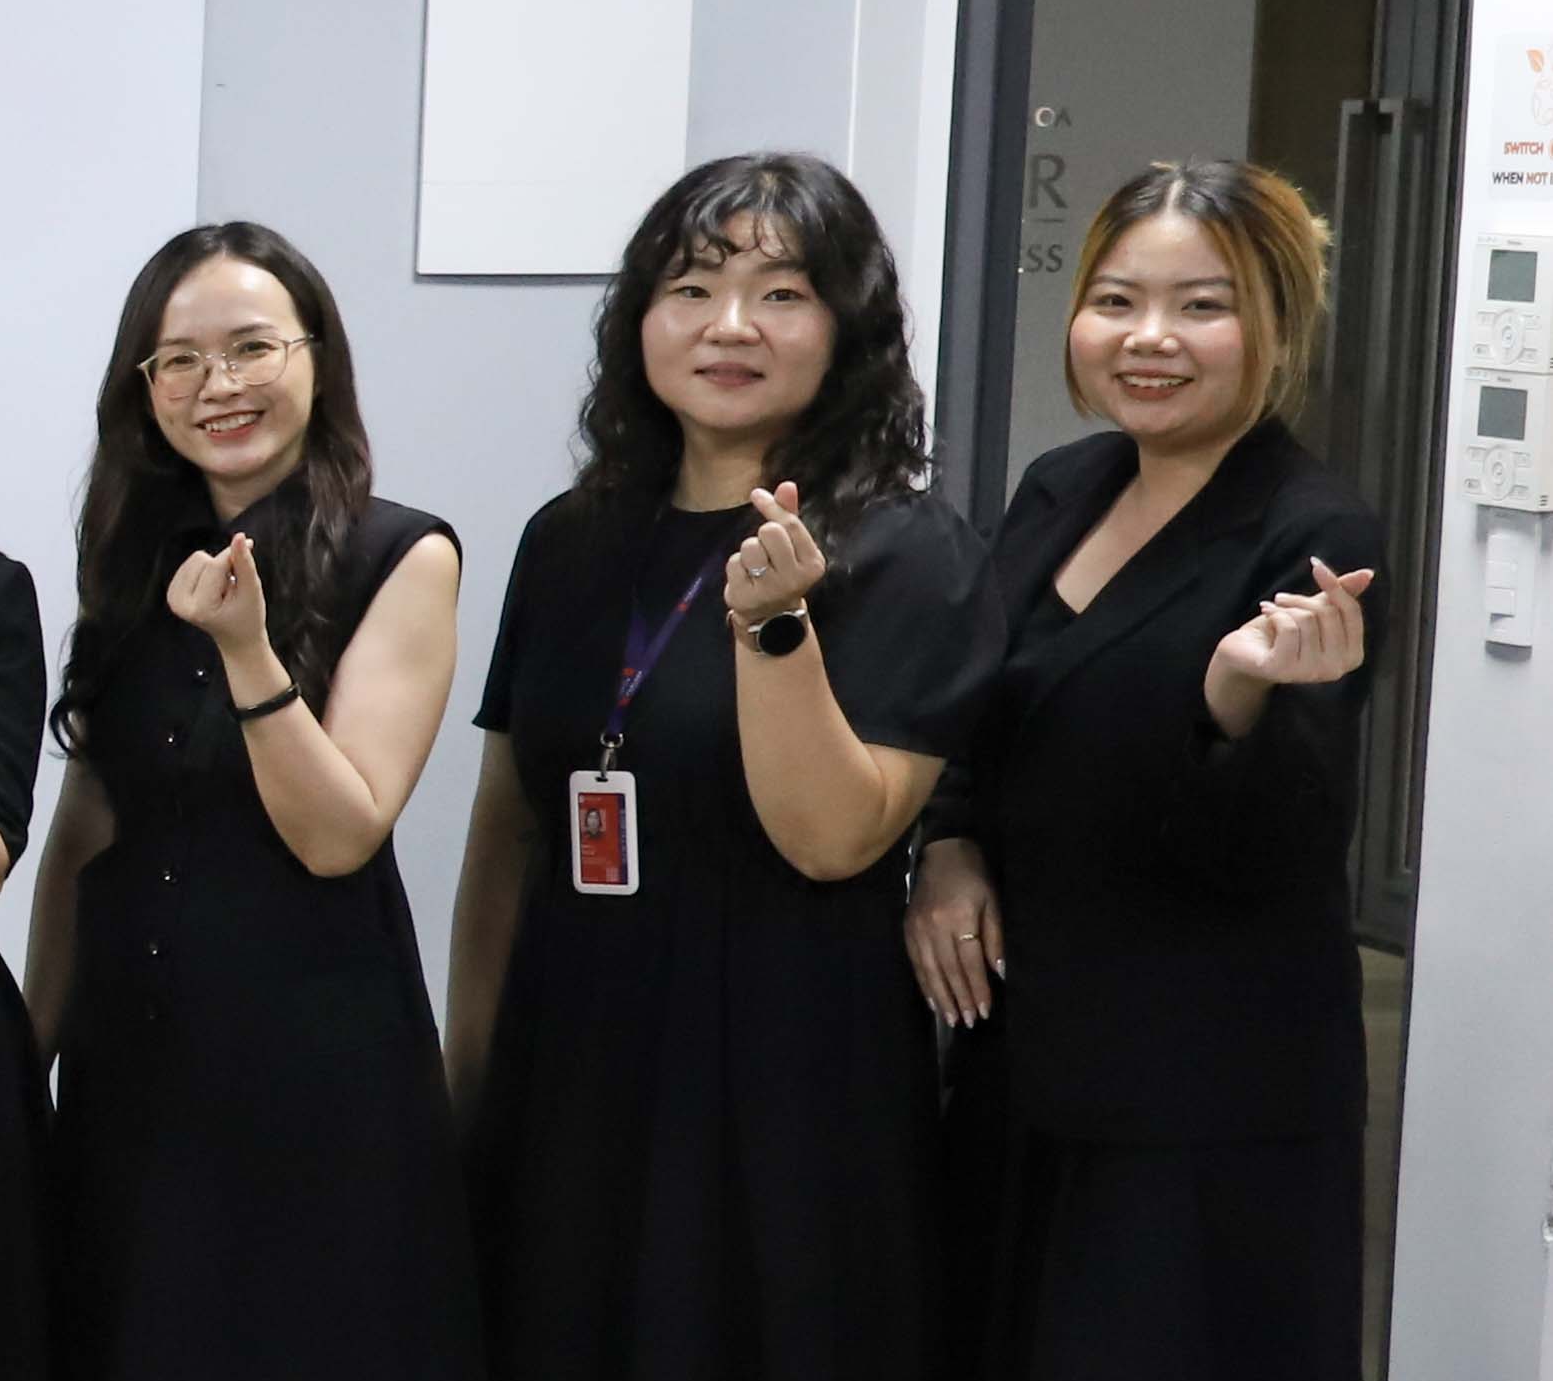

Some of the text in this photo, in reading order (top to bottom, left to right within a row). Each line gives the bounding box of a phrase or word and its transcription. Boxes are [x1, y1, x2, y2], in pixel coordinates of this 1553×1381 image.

[1503, 141, 1544, 155] SWITCH
[1492, 172, 1548, 185] WHEN NOT
